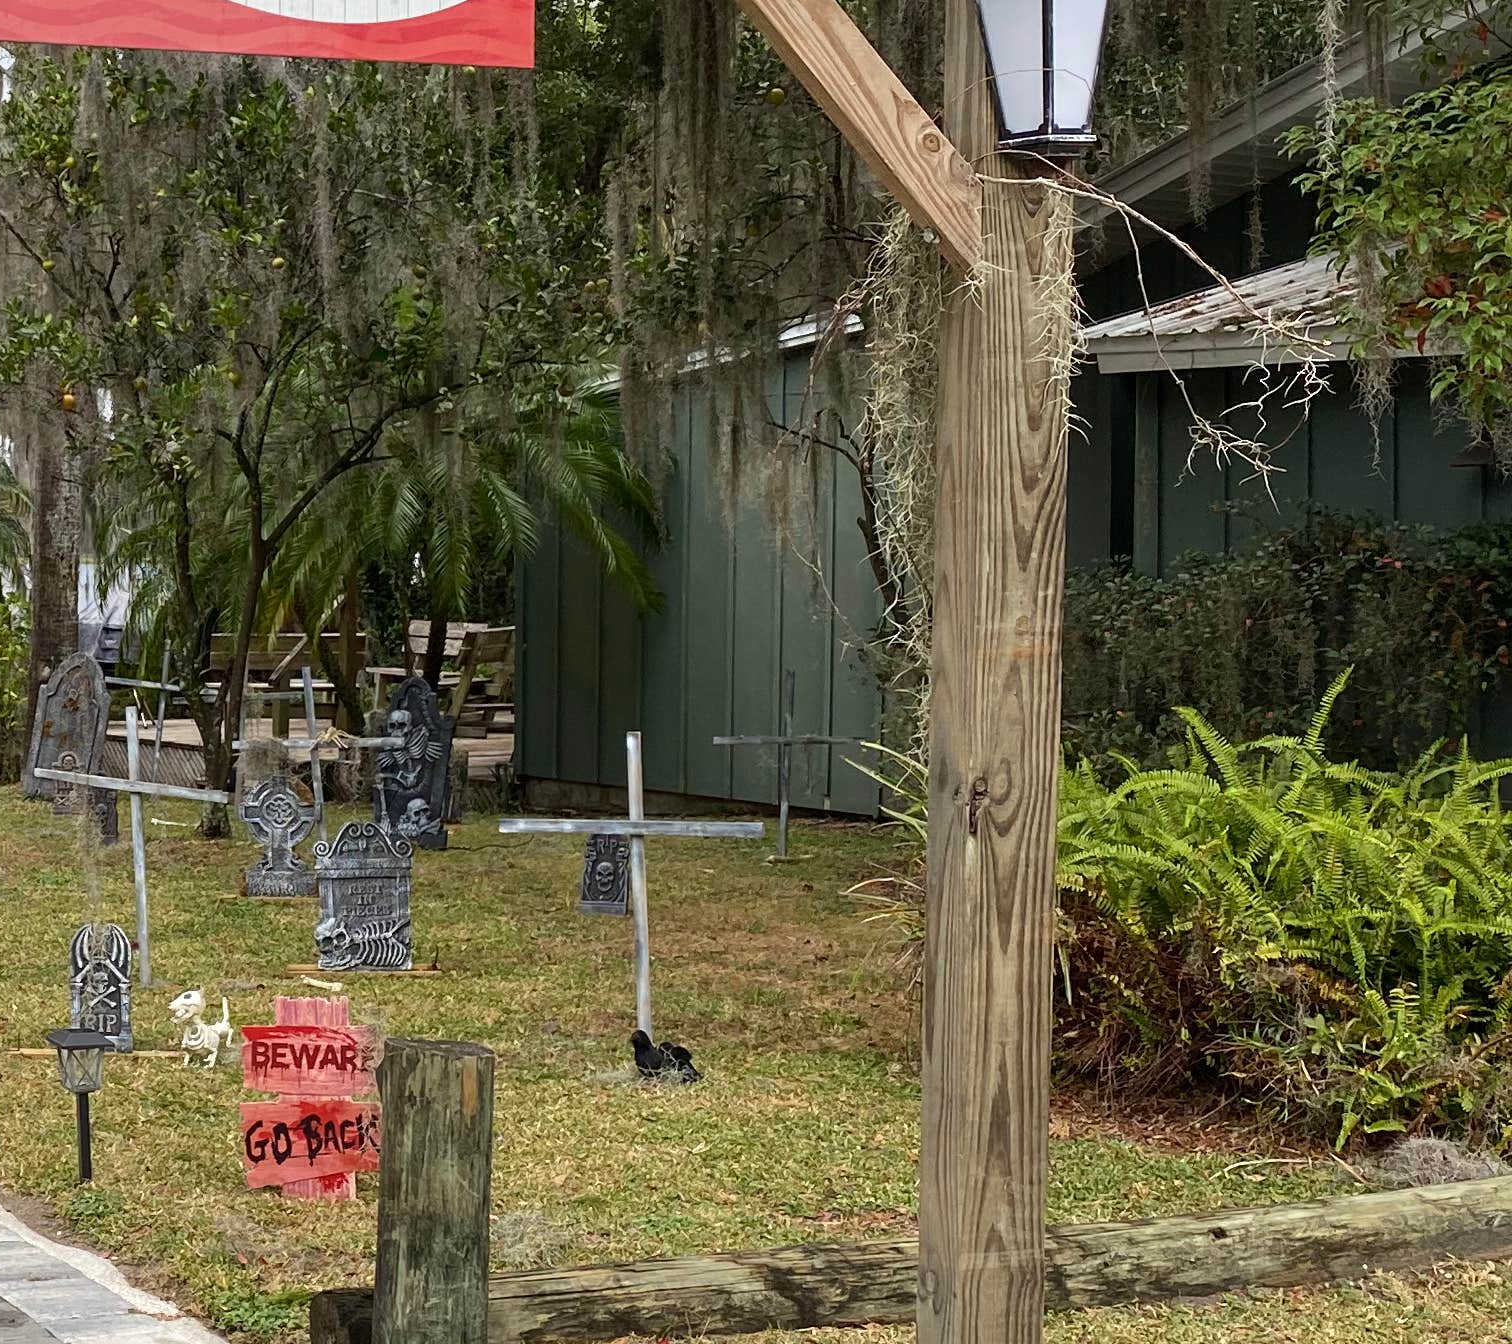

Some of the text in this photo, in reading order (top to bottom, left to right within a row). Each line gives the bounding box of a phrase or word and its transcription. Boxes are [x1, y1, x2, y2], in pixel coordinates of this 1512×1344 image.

[348, 882, 382, 895] REST
[84, 1014, 117, 1032] RIP
[245, 1113, 381, 1166] GO BACK
